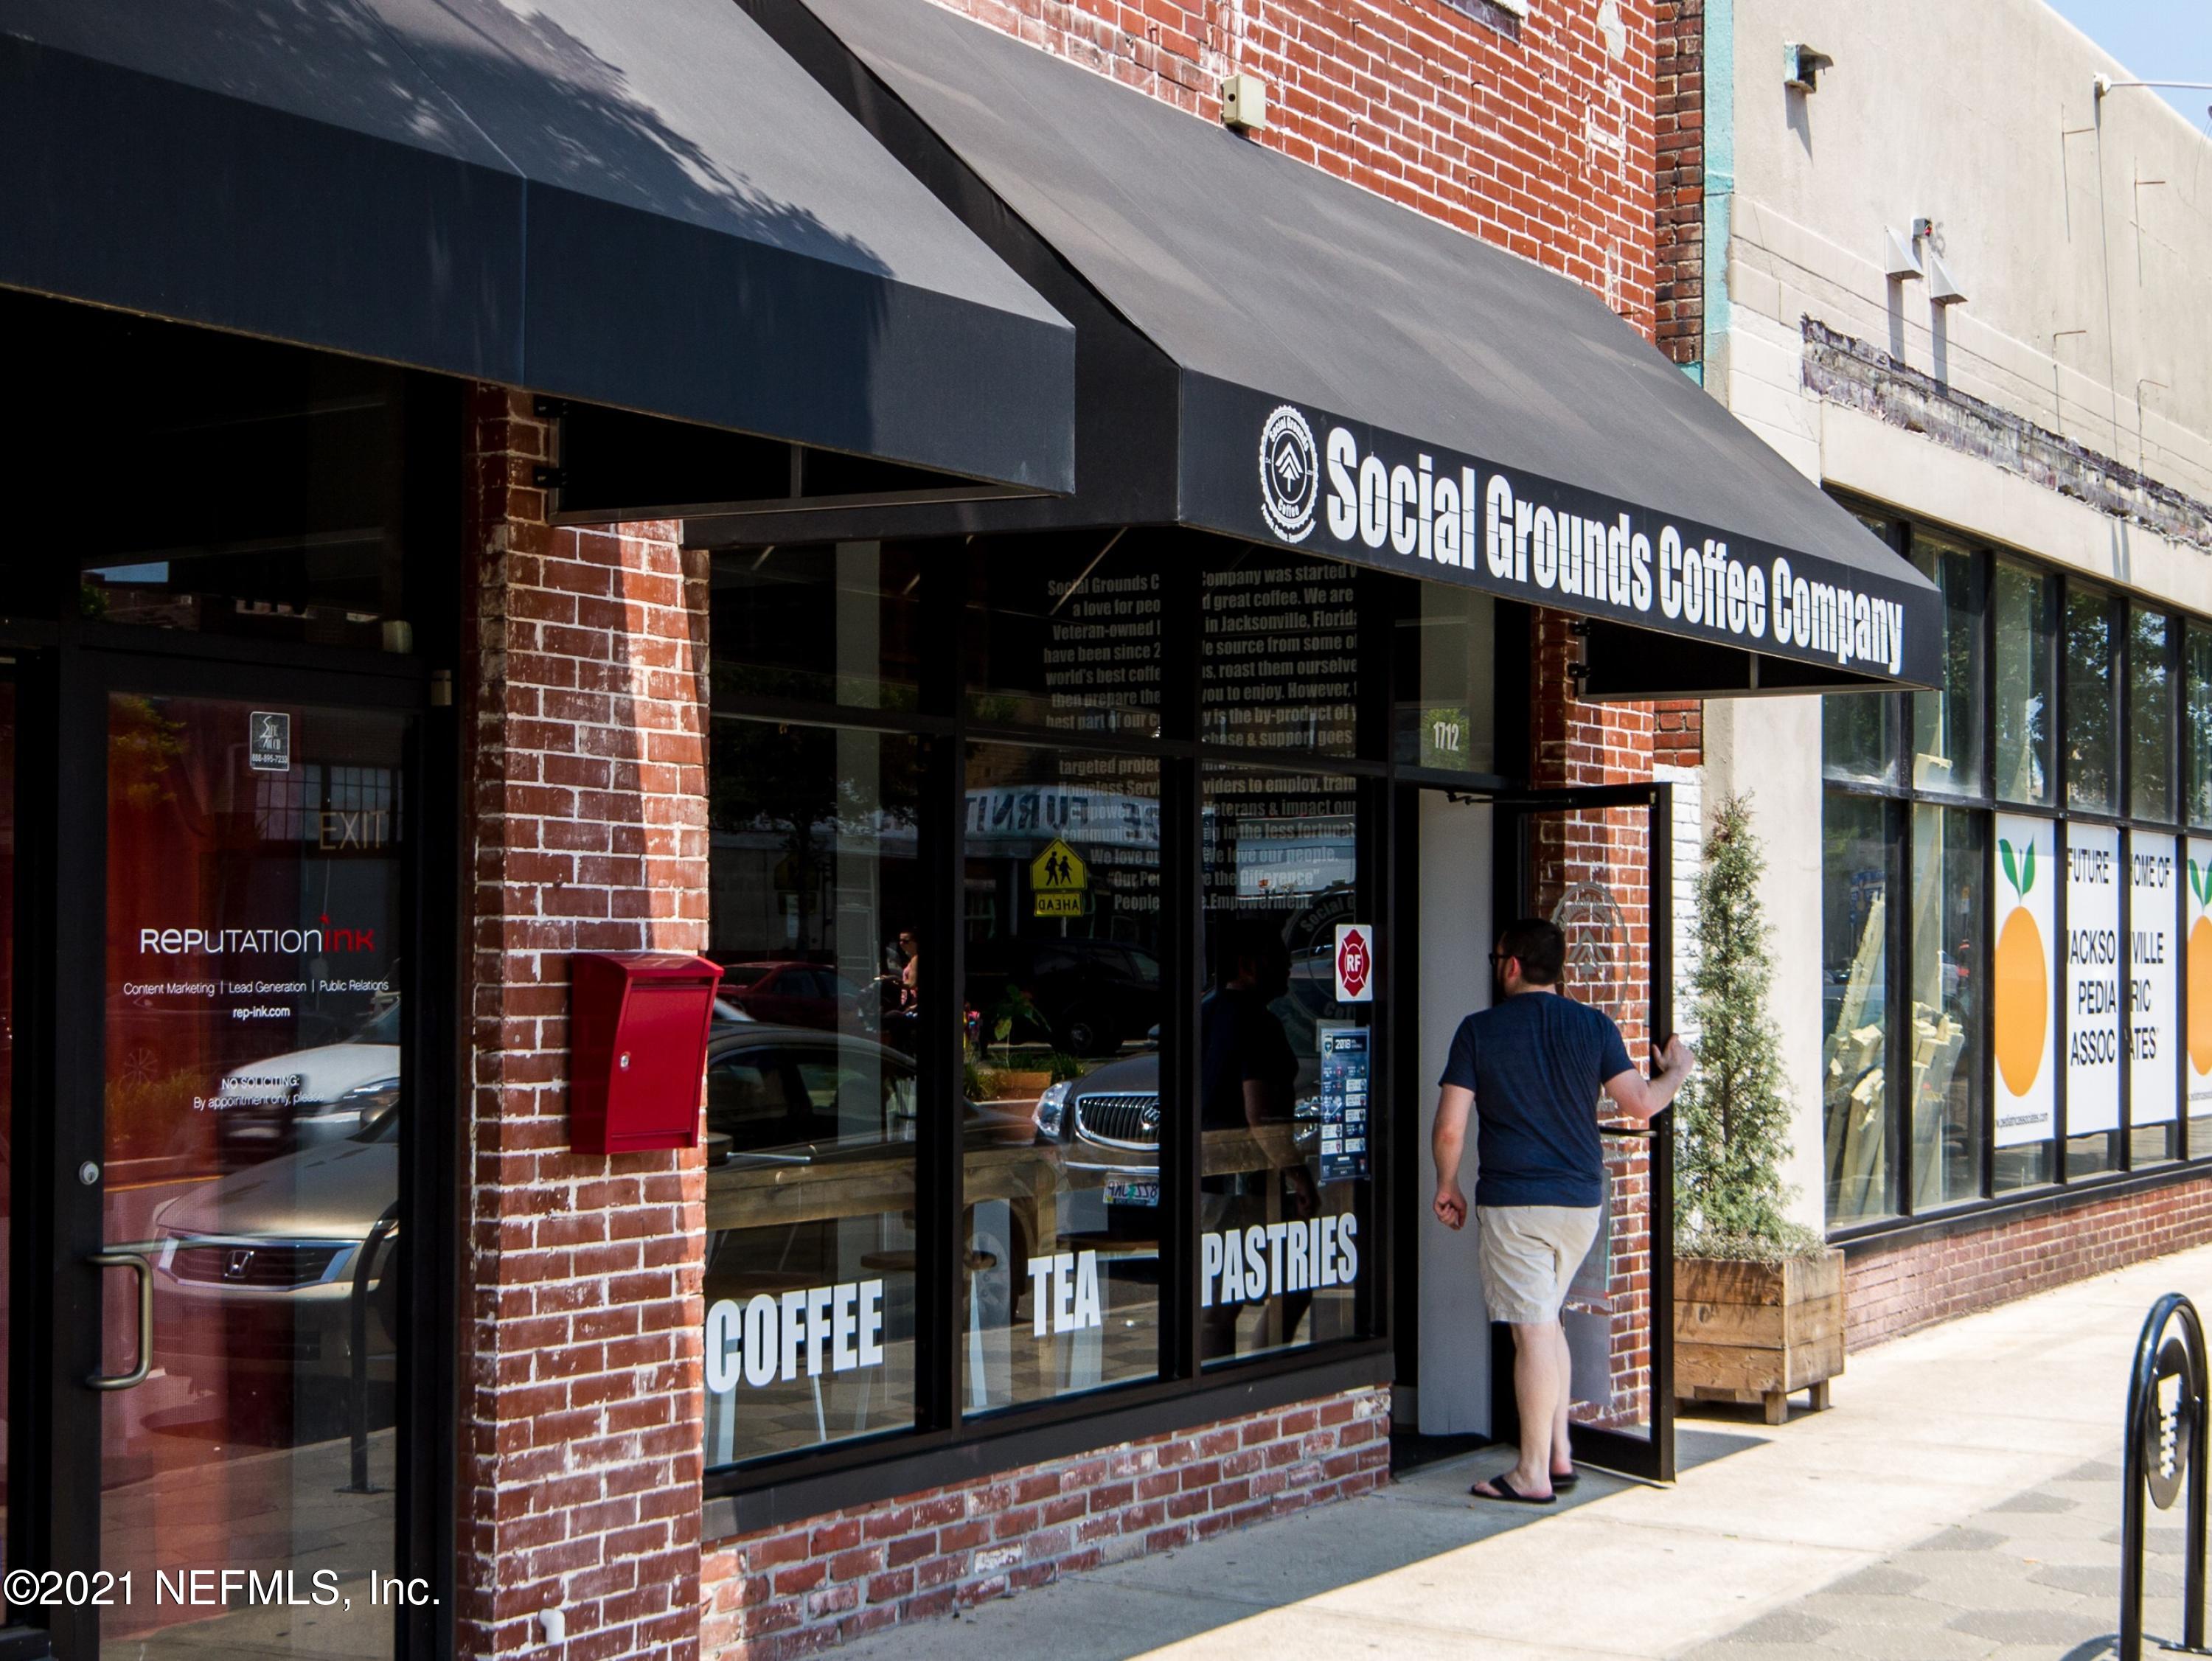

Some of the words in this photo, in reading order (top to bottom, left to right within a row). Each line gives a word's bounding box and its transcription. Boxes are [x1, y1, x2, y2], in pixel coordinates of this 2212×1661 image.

[1326, 426, 1476, 571] Social
[1486, 474, 1652, 613] Grounds
[1659, 525, 1767, 638] Coffee
[1772, 557, 1904, 675] Company
[1091, 574, 1148, 594] Grounds
[1203, 568, 1262, 587] ompany
[1264, 568, 1293, 582] was
[1295, 565, 1346, 582] started
[1072, 603, 1081, 618] a
[1083, 600, 1112, 616] love
[1113, 599, 1133, 615] for
[1214, 591, 1251, 611] great
[1304, 587, 1327, 605] We
[1329, 588, 1354, 603] are
[1052, 620, 1154, 641] Veteran-owned
[1205, 616, 1218, 633] in
[1220, 611, 1310, 633] Jacksonville,
[1043, 647, 1075, 664] have
[1078, 646, 1111, 662] been
[1113, 644, 1151, 661] since
[1216, 638, 1265, 655] source
[1267, 636, 1300, 652] from
[1303, 635, 1343, 651] some
[1046, 669, 1093, 686] world's
[1096, 667, 1126, 685] best
[1219, 661, 1256, 678] roast
[1258, 659, 1294, 676] them
[1296, 656, 1357, 675] ourselve
[1051, 692, 1082, 708] then
[1084, 690, 1138, 708] prepare
[1227, 686, 1240, 702] to
[1242, 683, 1285, 702] enjoy.
[1287, 680, 1351, 700] However,
[1046, 714, 1074, 730] best
[1077, 714, 1105, 731] part
[1123, 712, 1147, 728] our
[1229, 707, 1252, 724] the
[1254, 705, 1332, 725] by-product
[1335, 704, 1349, 720] of
[1318, 729, 1352, 746] goes
[1433, 720, 1460, 752] 1712
[1059, 759, 1116, 776] targeted
[1059, 781, 1123, 797] Homeless
[1248, 777, 1263, 793] to
[1265, 776, 1321, 794] employ,
[1268, 801, 1280, 816] &
[1281, 798, 1331, 816] impact
[318, 809, 391, 851] EXIT
[1223, 823, 1237, 840] in
[1239, 823, 1262, 840] the
[1264, 823, 1295, 840] less
[1090, 849, 1113, 865] We
[1115, 849, 1144, 865] love
[1227, 847, 1256, 863] love
[1259, 848, 1284, 863] our
[2067, 848, 2110, 885] FUTURE
[2157, 857, 2171, 889] OF
[1214, 871, 1237, 886] the
[1300, 897, 1345, 933] Social
[1346, 953, 1362, 972] RF
[123, 981, 164, 996] Content
[167, 981, 215, 997] Marketing
[229, 981, 253, 994] Lead
[254, 980, 307, 994] Generation
[319, 978, 347, 993] Public
[349, 977, 389, 992] Relations
[232, 1004, 291, 1021] rep-ink.com
[1335, 1038, 1351, 1050] 2018
[221, 1078, 239, 1090] NO
[193, 1096, 206, 1111] By
[208, 1095, 270, 1110] appointment
[293, 1091, 324, 1106] please
[1201, 1211, 1357, 1307] PASTRIES
[1027, 1249, 1102, 1338] TEA
[705, 1278, 883, 1394] COFFEE
